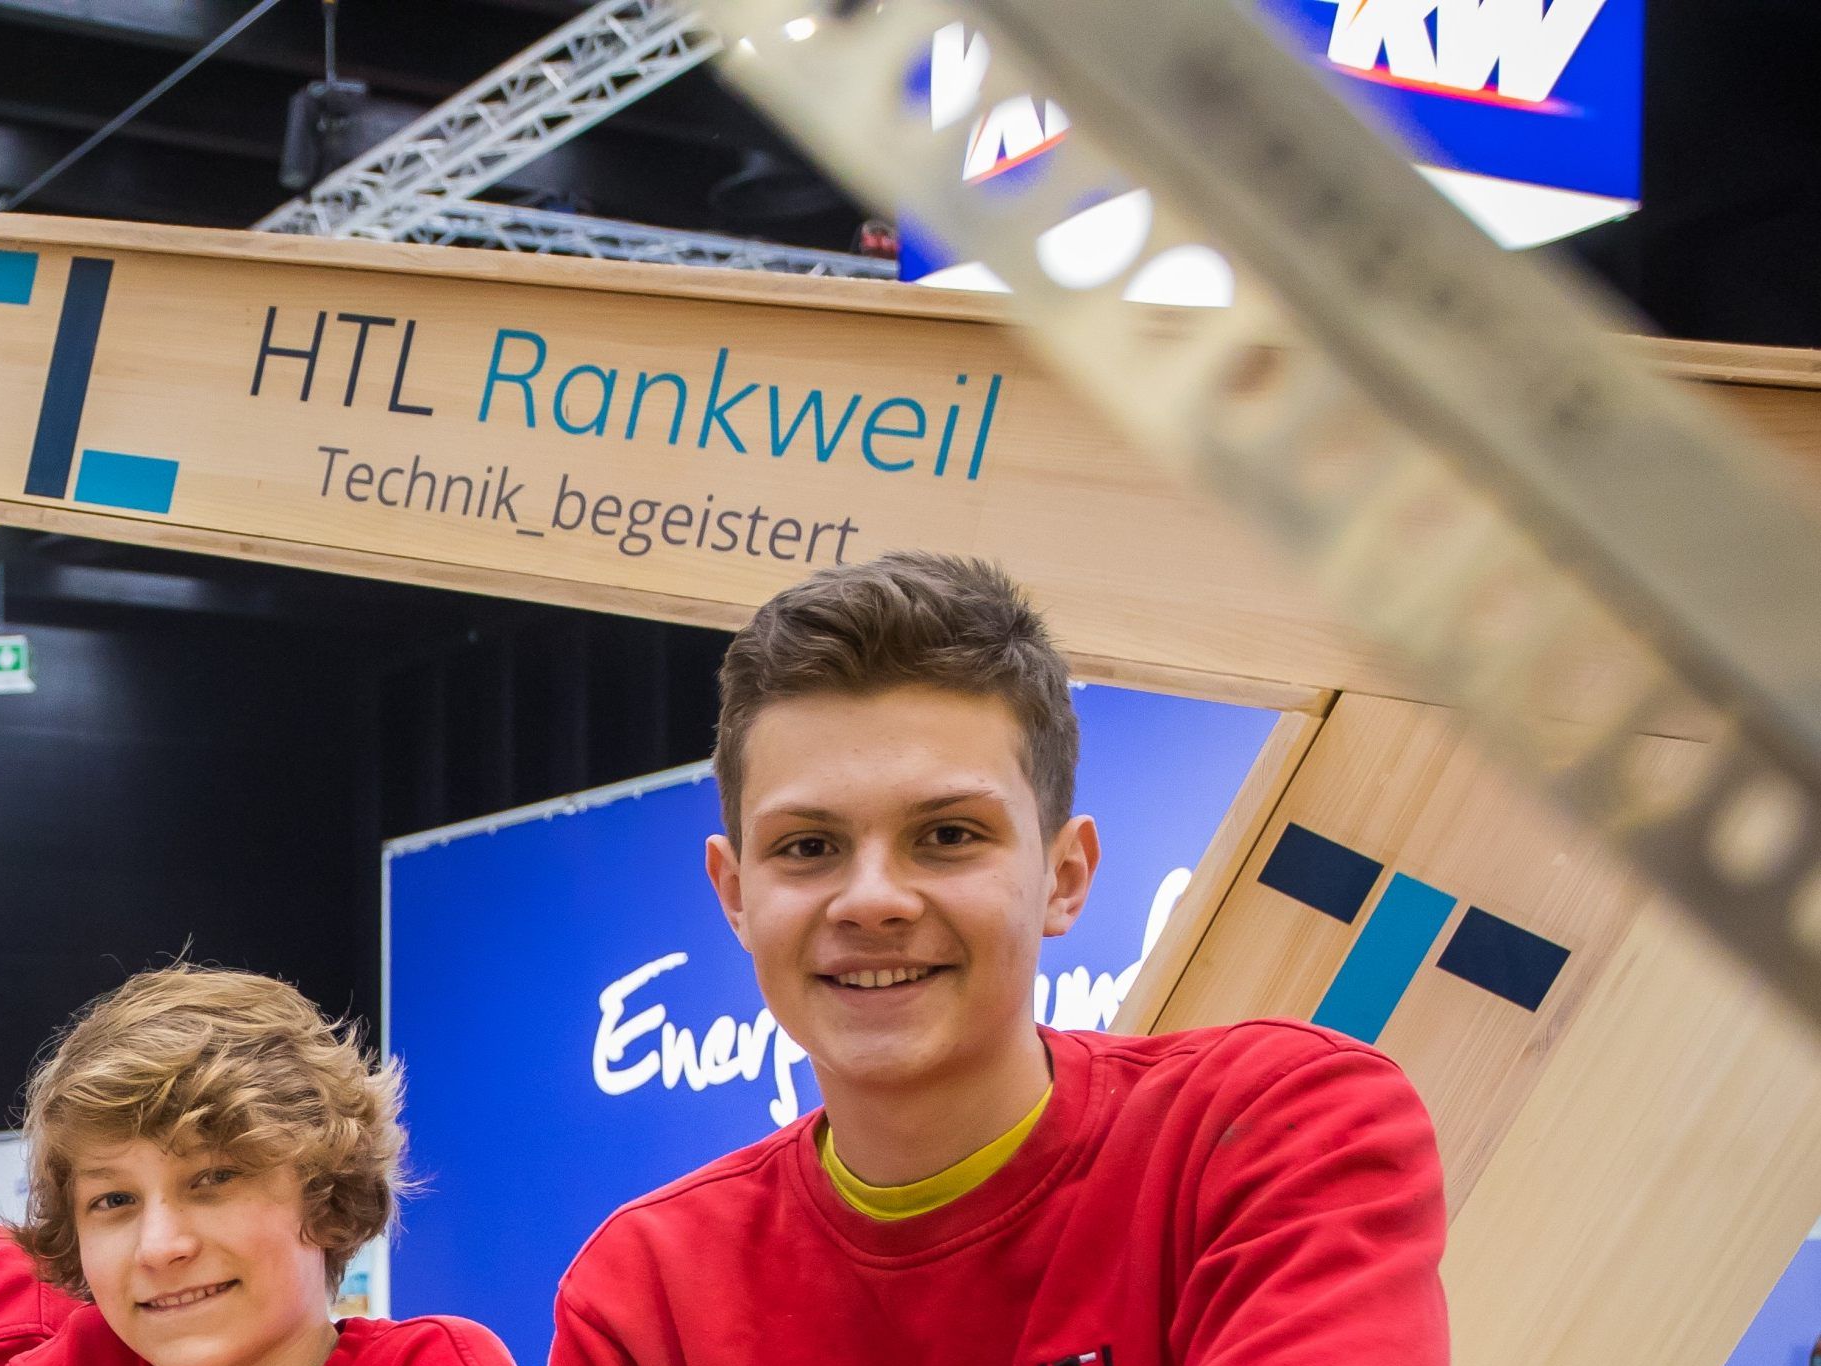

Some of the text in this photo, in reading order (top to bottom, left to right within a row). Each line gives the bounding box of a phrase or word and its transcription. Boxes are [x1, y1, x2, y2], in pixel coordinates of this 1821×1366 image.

[249, 305, 1004, 482] HTL Rankweil
[315, 445, 860, 566] Technik_begeistert
